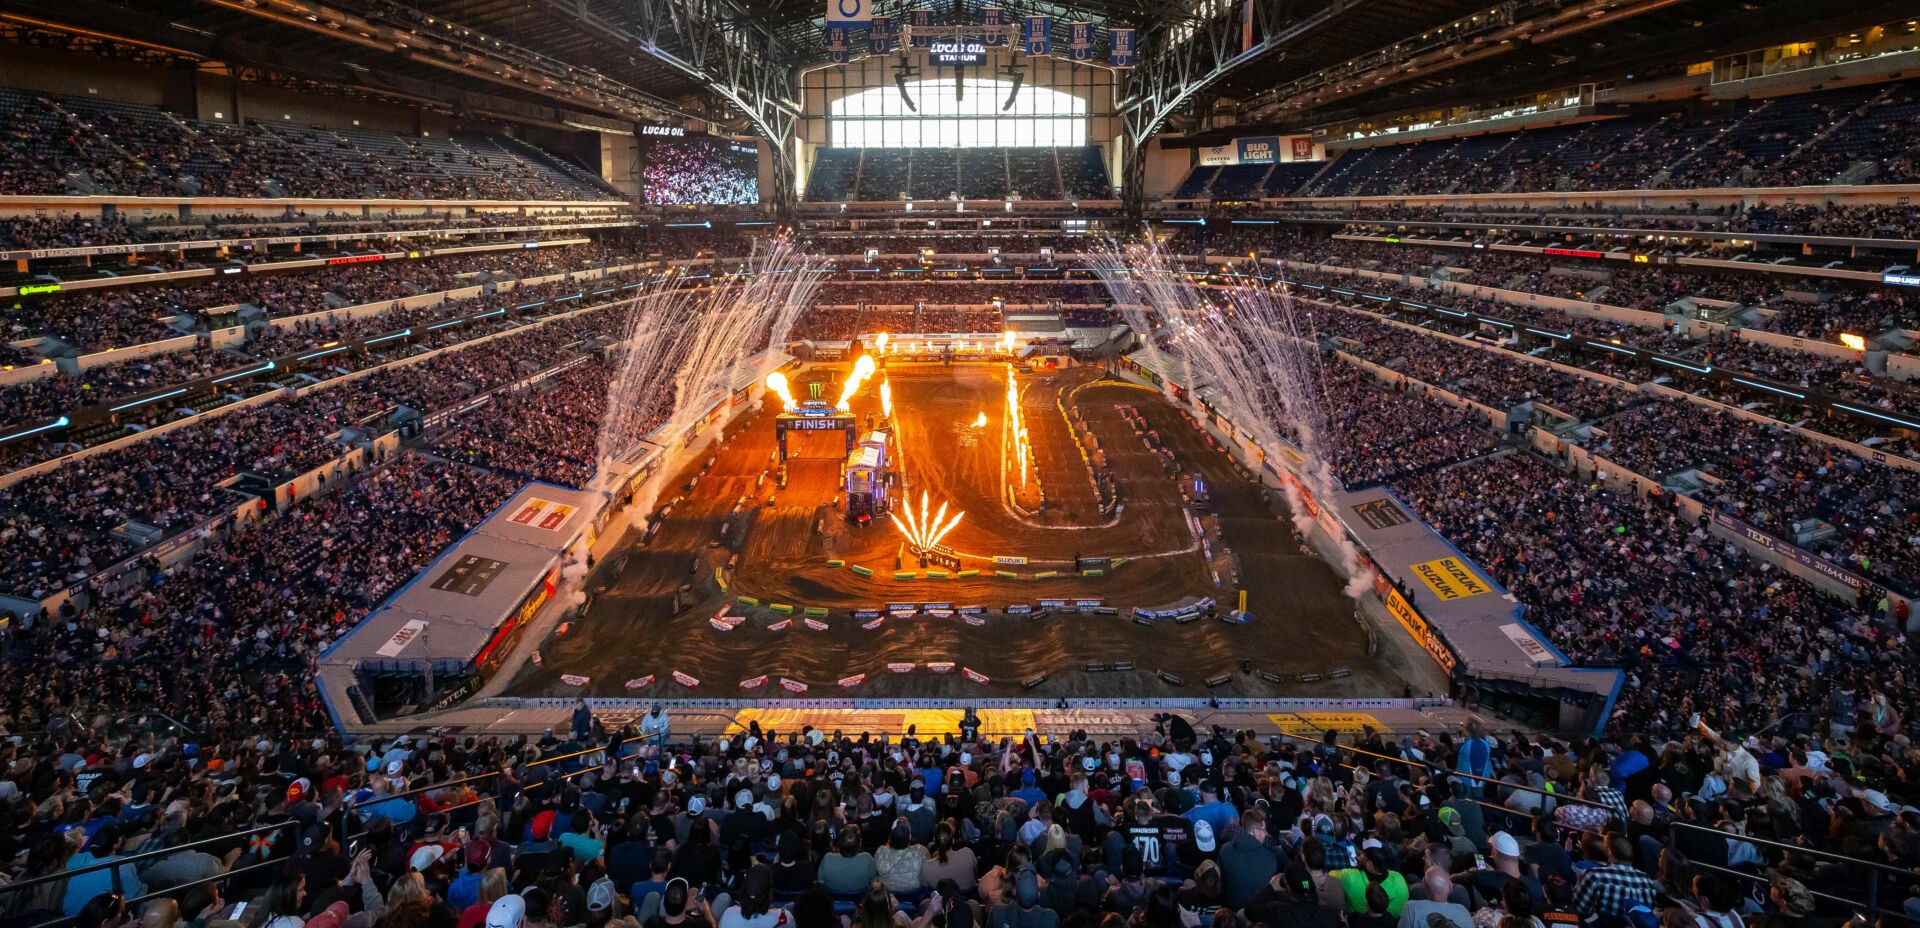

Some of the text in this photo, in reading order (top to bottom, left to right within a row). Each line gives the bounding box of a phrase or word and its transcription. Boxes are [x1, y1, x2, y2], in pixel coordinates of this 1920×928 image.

[967, 44, 986, 53] OIL
[643, 126, 685, 137] LUCAS OIL
[1246, 143, 1269, 152] BUD
[1243, 150, 1273, 160] LIGHT
[31, 250, 46, 259] TED
[795, 420, 835, 429] FINISH
[1746, 528, 1772, 547] TEXT
[996, 556, 1024, 564] SUZUKI
[1440, 557, 1484, 594] SUZUKI
[1417, 564, 1460, 600] SUZUKI
[1388, 595, 1426, 640] SUZUKI
[1132, 836, 1160, 863] 170
